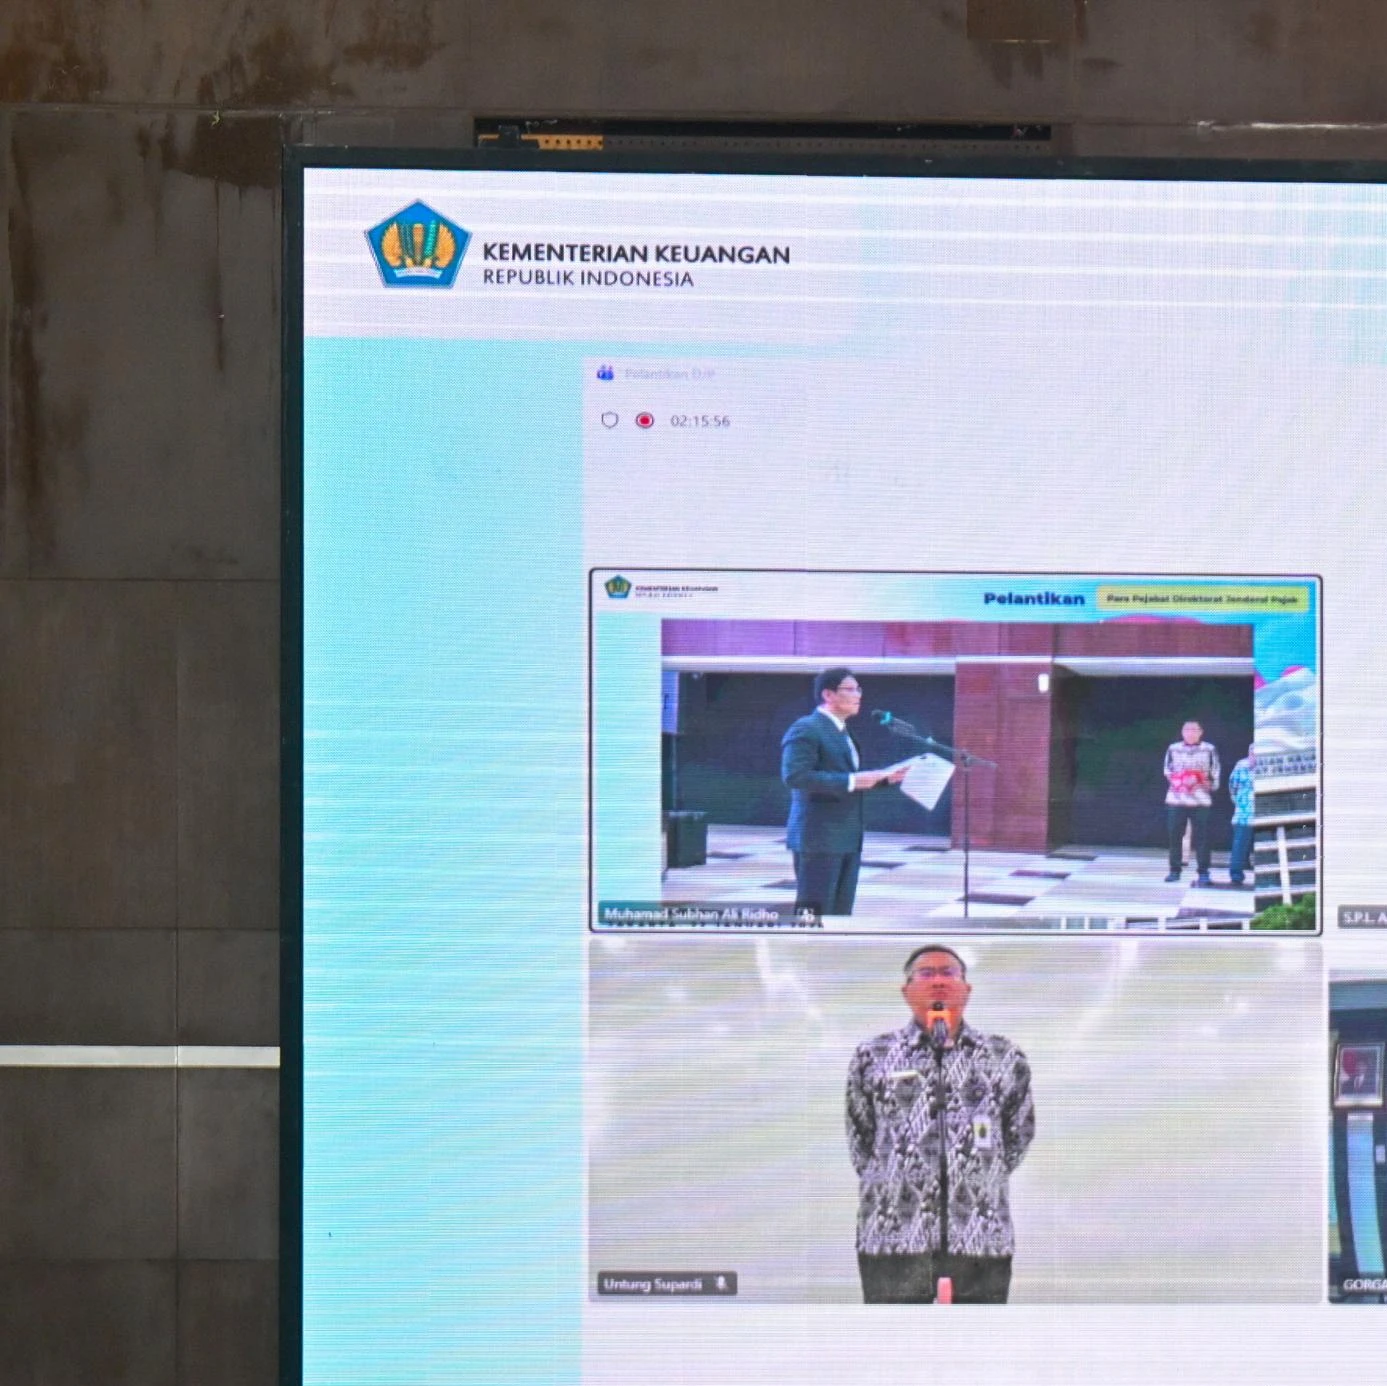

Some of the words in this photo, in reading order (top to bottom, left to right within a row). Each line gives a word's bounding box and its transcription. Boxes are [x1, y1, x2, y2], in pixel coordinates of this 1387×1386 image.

[483, 242, 648, 264] KEMENTERIAN
[654, 245, 791, 265] KEUANGAN
[483, 268, 574, 286] REPUBLIK
[580, 270, 694, 288] INDONESIA
[670, 415, 731, 428] 02:15:56
[983, 592, 1086, 607] Pelantikan
[604, 907, 669, 920] Muhamad
[671, 908, 717, 920] Subhan
[722, 908, 738, 920] Ali
[741, 908, 779, 921] Ridho
[603, 1278, 650, 1294] Untung
[654, 1277, 703, 1293] Supardi
